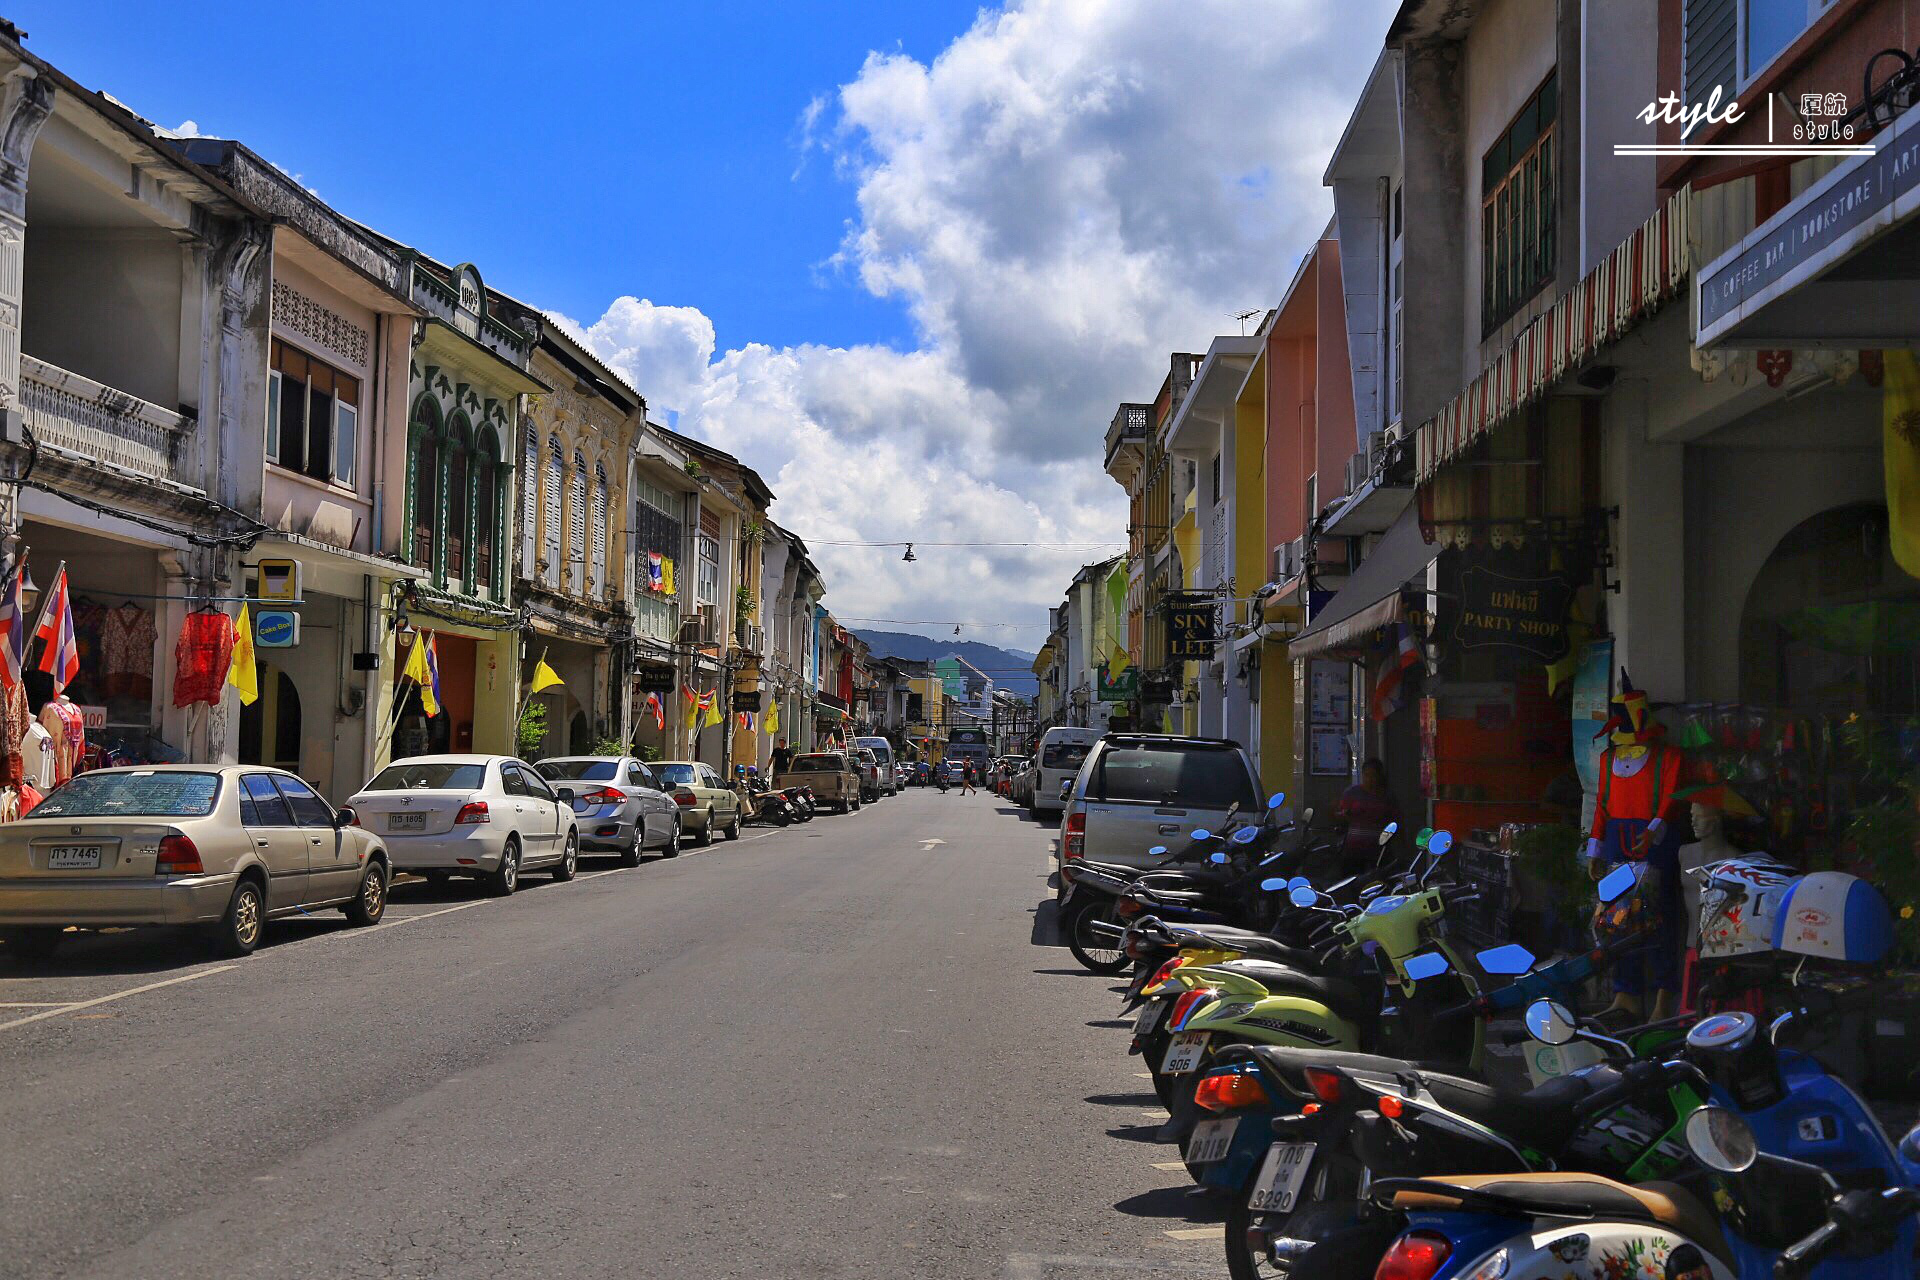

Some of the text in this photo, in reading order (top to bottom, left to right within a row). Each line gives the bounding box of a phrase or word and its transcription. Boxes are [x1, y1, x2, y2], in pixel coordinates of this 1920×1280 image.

[1723, 258, 1760, 298] COFFEE
[1765, 241, 1785, 270] BAR
[1802, 179, 1872, 244] BOOKSTORE
[260, 622, 292, 635] Cake Box
[1174, 614, 1208, 629] SIN
[1464, 611, 1561, 637] PARTY SHOP
[1184, 628, 1197, 640] &
[1171, 640, 1211, 655] LEE
[405, 815, 423, 823] 1805
[71, 847, 98, 859] 7445
[1168, 1058, 1192, 1071] 906
[1253, 1188, 1293, 1210] 3290
